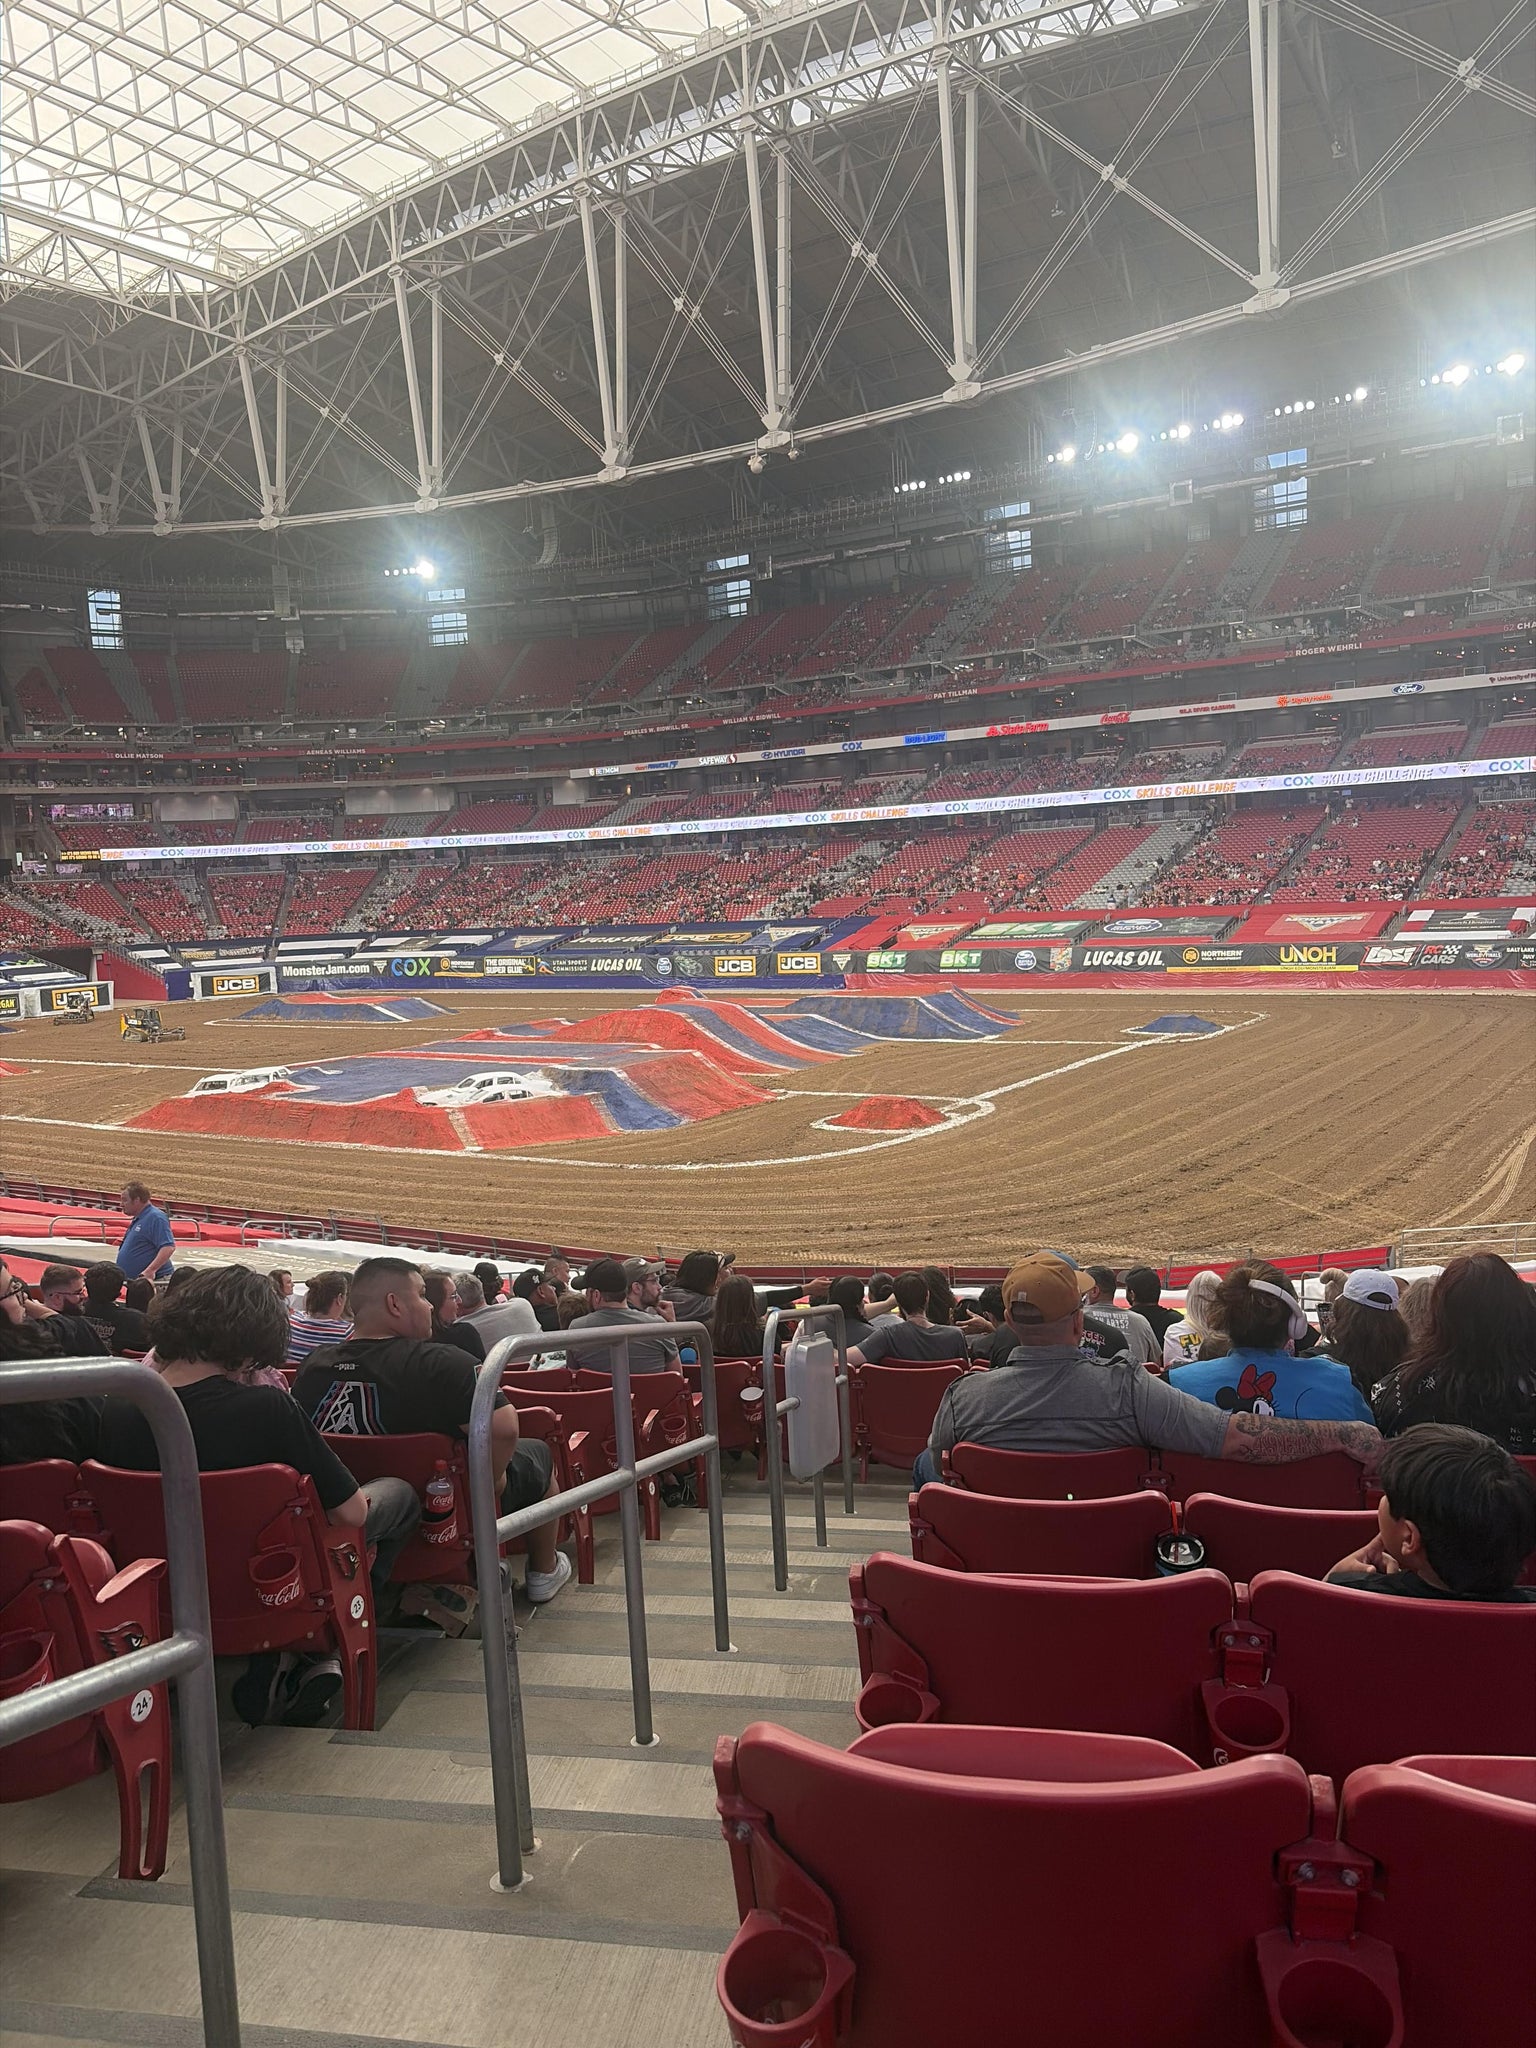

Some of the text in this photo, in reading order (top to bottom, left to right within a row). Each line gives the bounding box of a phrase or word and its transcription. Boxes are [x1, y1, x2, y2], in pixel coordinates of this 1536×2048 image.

[1296, 646, 1325, 656] ROGER
[1328, 642, 1362, 652] WEHRLI
[948, 689, 978, 697] TILLMAN
[1000, 722, 1049, 735] State Farm
[842, 742, 862, 751] COX
[774, 748, 805, 758] HYUNDAI
[699, 755, 727, 765] SAFEWAY
[1489, 760, 1524, 772] COX
[596, 766, 620, 775] BETMGM
[1283, 775, 1314, 787] COX
[1103, 782, 1237, 800] COX SKILLS CHALLENGE
[945, 803, 969, 813] COX
[805, 807, 909, 823] COX SKILLS CHALLENGE
[567, 827, 653, 839] COX SKILLS CHALLENGE
[681, 823, 700, 832] COX
[305, 843, 328, 851] COX
[441, 837, 462, 845] COX
[1280, 944, 1337, 963] UNOH
[1424, 945, 1443, 954] RC
[781, 957, 817, 970] JCB
[940, 951, 982, 968] BKT
[1083, 950, 1163, 966] LUCAS OIL
[1421, 954, 1456, 964] CARS
[282, 963, 370, 977] MonsterJam.com
[391, 958, 431, 977] COX
[591, 959, 624, 972] LUCAS
[625, 958, 643, 972] OIL
[718, 960, 752, 973] JCB
[217, 978, 256, 991] JCB
[136, 1697, 148, 1716] 24
